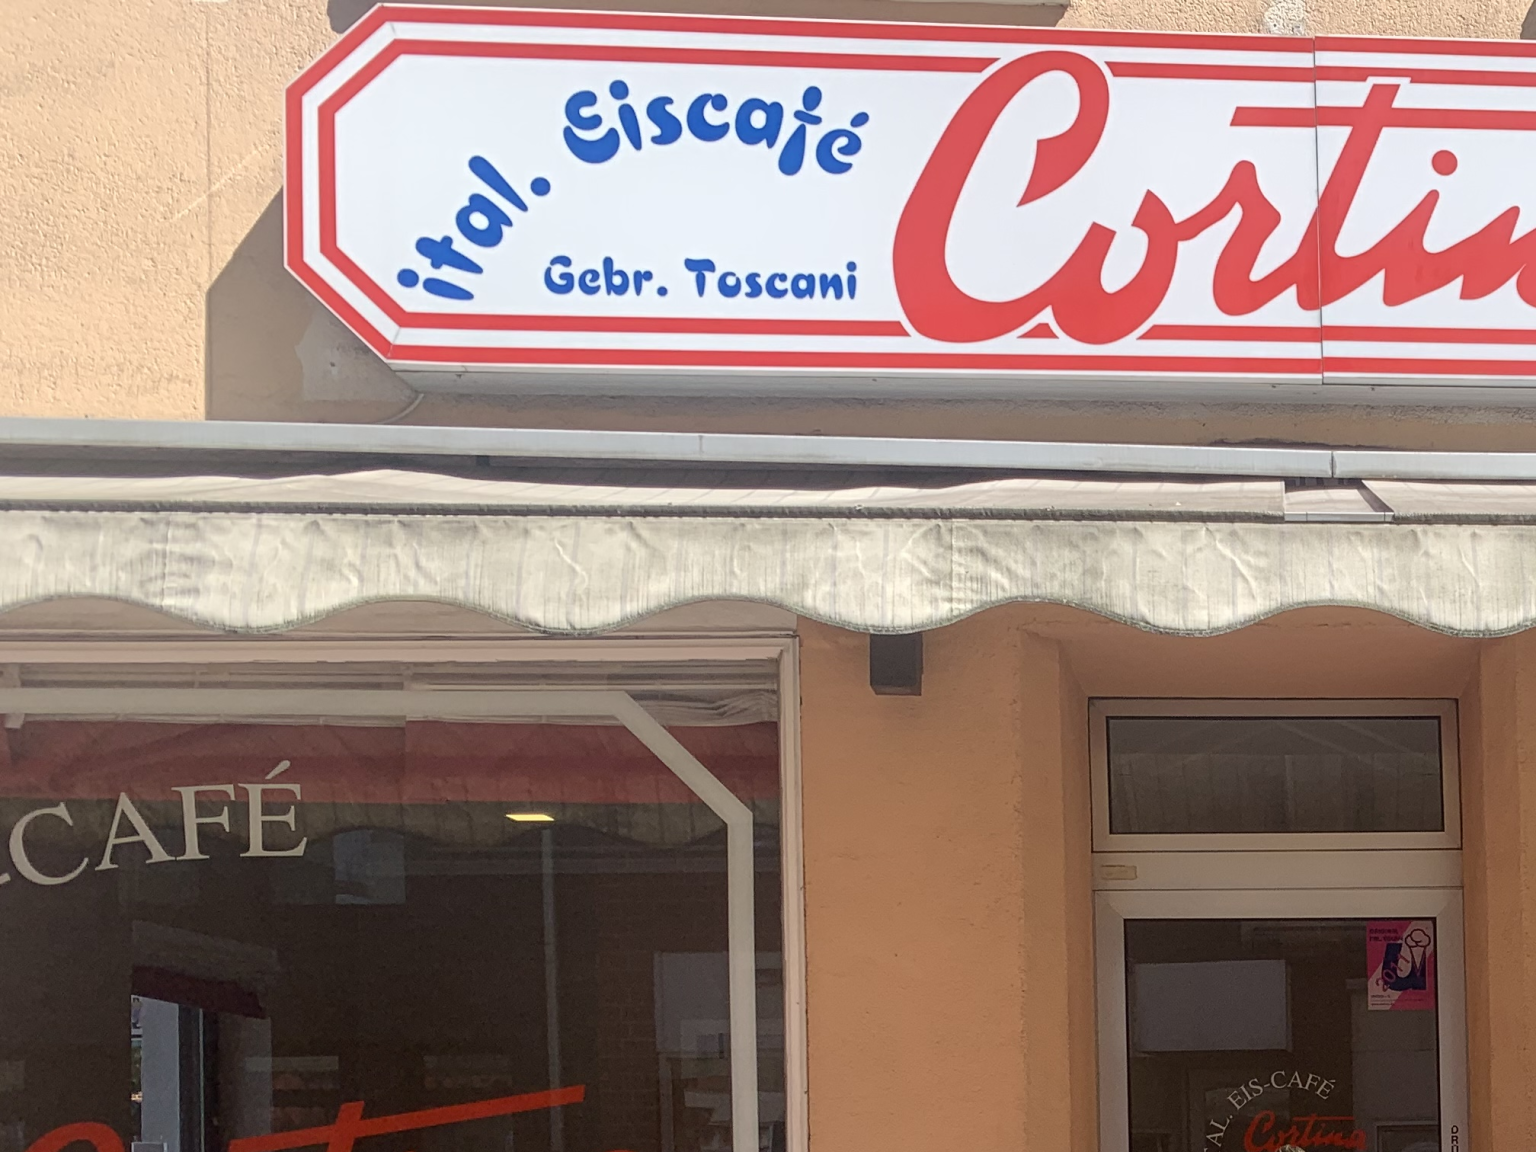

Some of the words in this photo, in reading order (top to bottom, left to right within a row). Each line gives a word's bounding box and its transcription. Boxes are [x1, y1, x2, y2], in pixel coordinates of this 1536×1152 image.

[397, 155, 551, 300] ital.
[563, 79, 869, 177] Eiscafé
[544, 255, 669, 298] Gebr.
[684, 257, 858, 300] Toscani
[1227, 1070, 1336, 1110] EIS-CAFÉ
